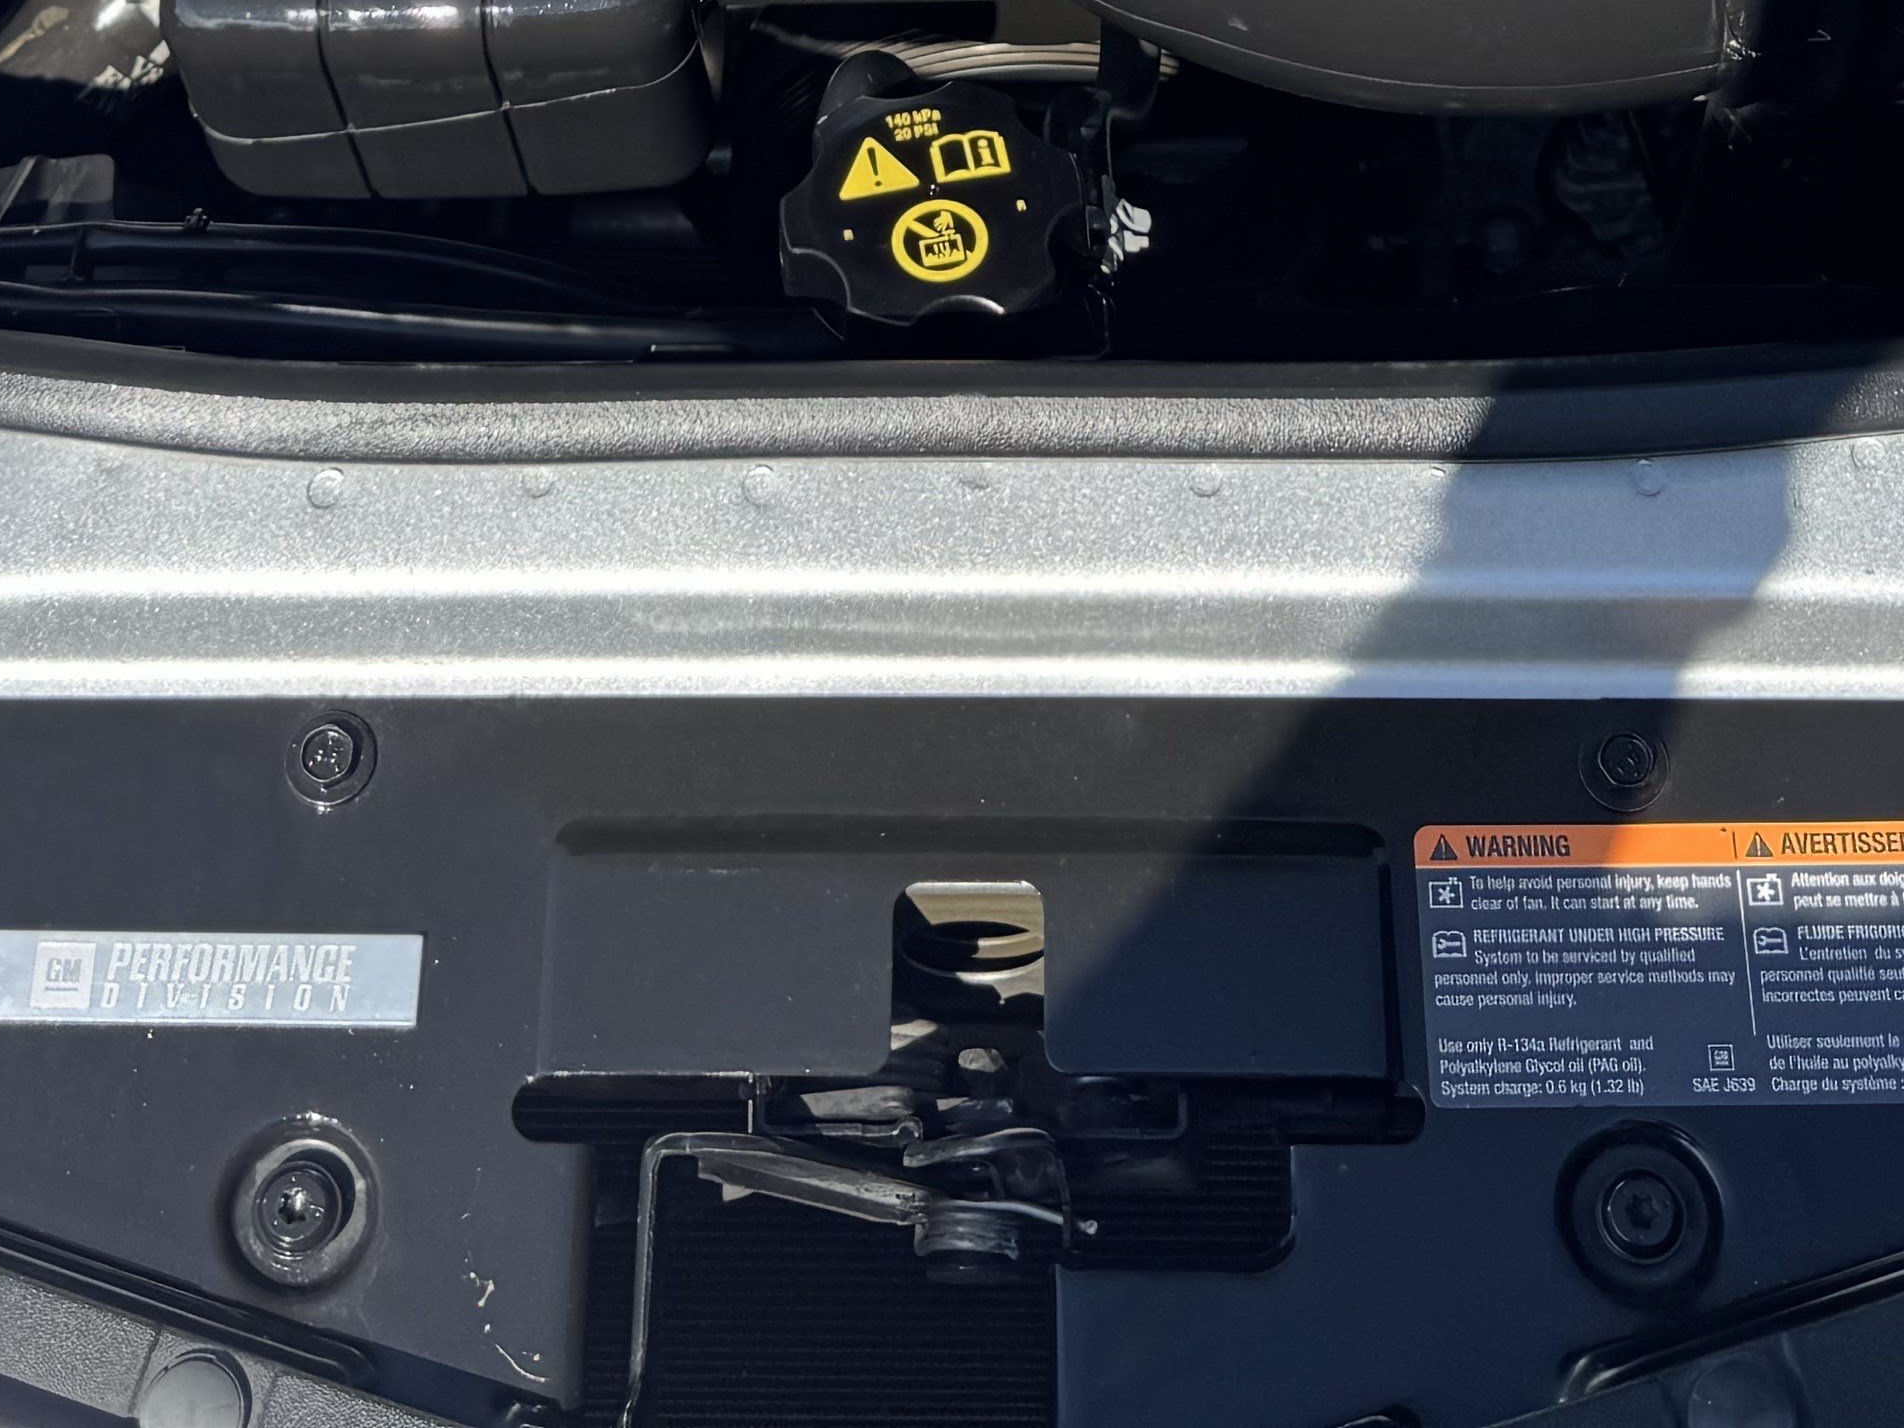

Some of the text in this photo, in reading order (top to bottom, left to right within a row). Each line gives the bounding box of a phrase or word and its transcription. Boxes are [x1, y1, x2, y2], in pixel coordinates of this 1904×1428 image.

[885, 112, 911, 129] 140
[894, 127, 912, 142] 20
[1466, 835, 1571, 858] WARNING
[1469, 873, 1731, 892] To help avoid personal injury, keep hands
[1791, 872, 1849, 887] Attention
[1853, 873, 1875, 886] aux
[1471, 896, 1699, 911] clear of fan. It can start at any time.
[1793, 892, 1823, 911] peut
[1826, 894, 1841, 907] se
[1845, 892, 1887, 907] mettre
[1891, 891, 1899, 906] à
[1473, 927, 1724, 943] REFRIGERANT UNDER HIGH PRESSURE
[1797, 925, 1844, 940] FLUIDE
[1475, 948, 1695, 967] System to be serviced by qualified
[1874, 946, 1891, 959] du
[45, 957, 82, 984] GM
[106, 941, 359, 984] PERFORMANCE
[1435, 972, 1497, 988] personnel
[1598, 971, 1644, 984] service
[1648, 969, 1703, 983] methods
[1708, 971, 1735, 985] may
[1760, 968, 1823, 984] personnel
[1827, 967, 1875, 984] qualifié
[100, 983, 352, 1012] DIVISION
[1436, 992, 1577, 1009] cause personal injury.
[1839, 988, 1891, 1004] peuvent
[1439, 1036, 1653, 1055] Use only R-134a Refrigerant and
[1767, 1034, 1811, 1049] Utiliser
[1816, 1034, 1885, 1048] seulement
[1888, 1034, 1899, 1047] le
[1440, 1058, 1646, 1076] Polyalkylene Glycol oil (PAG oil).
[1769, 1056, 1786, 1070] de
[1833, 1058, 1849, 1069] au
[1441, 1079, 1644, 1098] System charge: 0.6 kg (1.32 lb)
[1692, 1078, 1756, 1092] SAE J639
[1771, 1077, 1818, 1094] Charge
[1822, 1077, 1838, 1090] du
[1842, 1076, 1897, 1093] système
